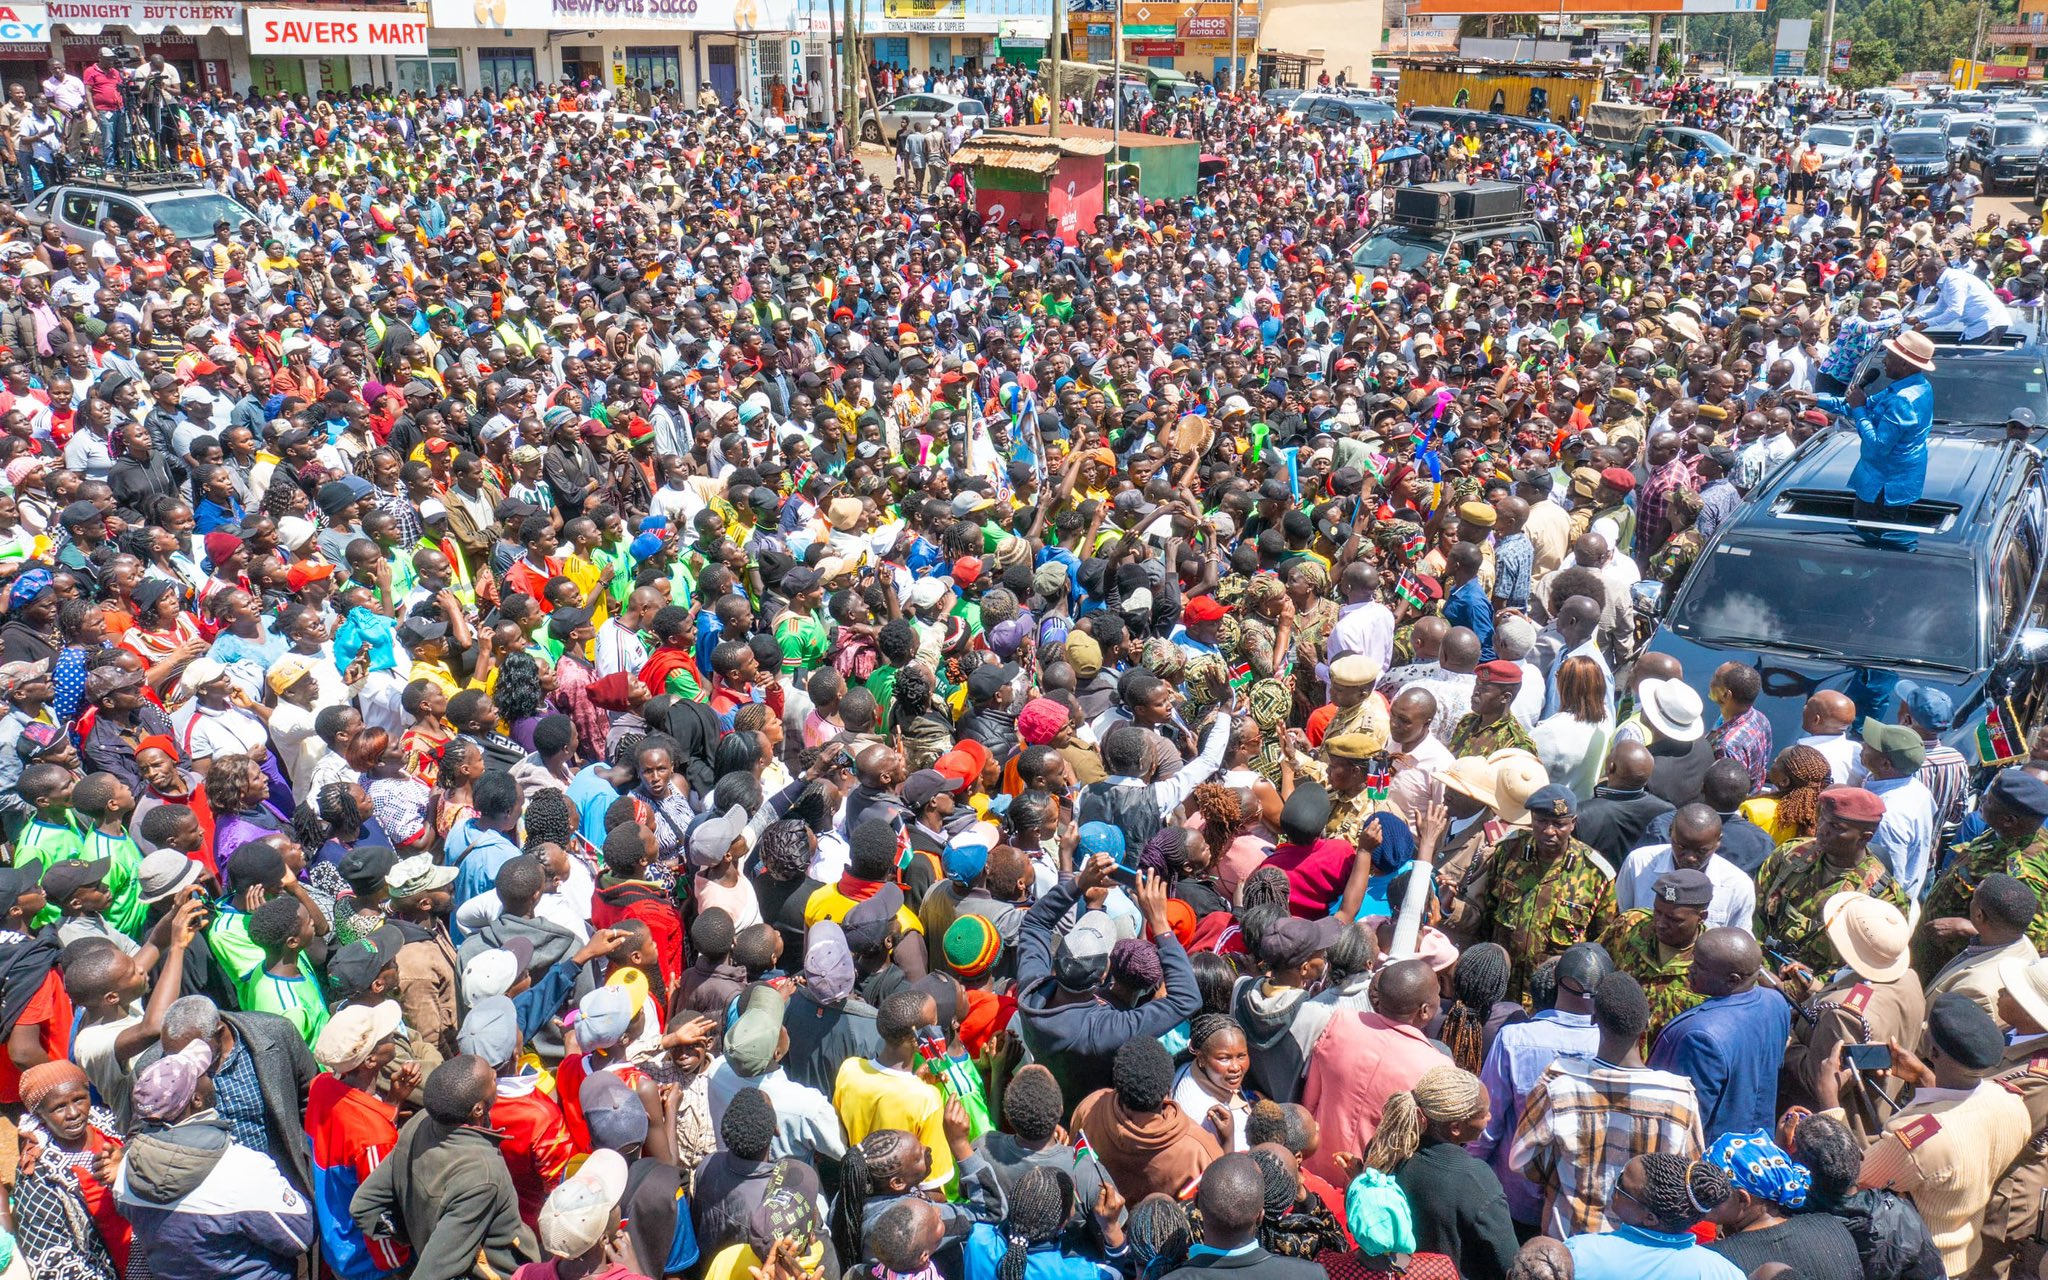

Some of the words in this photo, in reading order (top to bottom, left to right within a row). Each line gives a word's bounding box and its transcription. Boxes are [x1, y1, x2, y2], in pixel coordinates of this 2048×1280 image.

[48, 4, 132, 18] MIDNIGHT
[143, 5, 236, 19] BUTCHERY
[649, 0, 698, 13] Sacco
[888, 22, 907, 31] CHINGA
[910, 22, 935, 31] HARDWARE
[944, 22, 965, 31] SUPPLIES
[1190, 19, 1226, 29] ENEOS
[0, 23, 44, 39] CY
[265, 21, 358, 43] SAVERS
[369, 23, 426, 44] MART
[61, 35, 119, 46] MIDNIGHT
[0, 44, 46, 53] BUTCHERY
